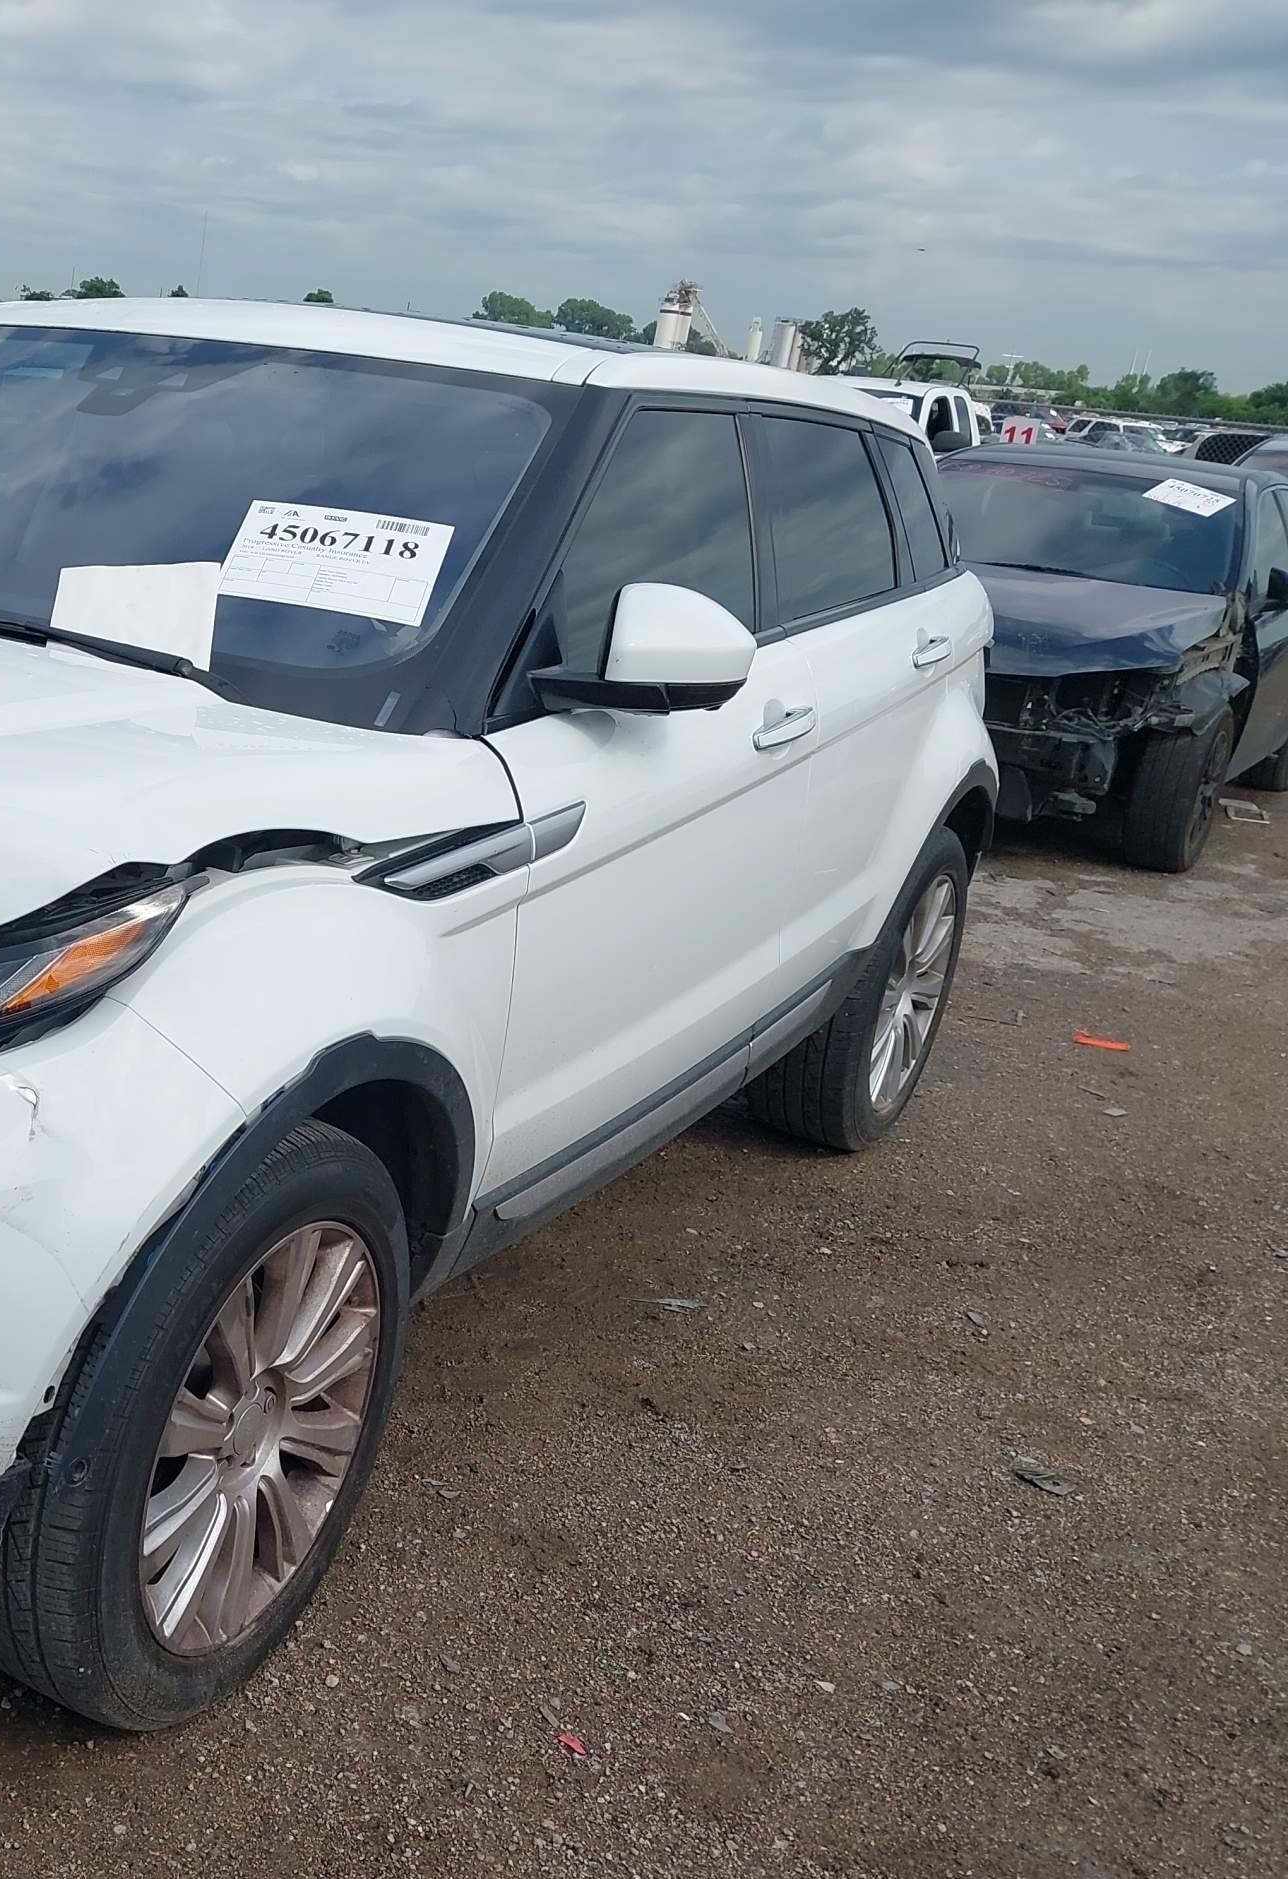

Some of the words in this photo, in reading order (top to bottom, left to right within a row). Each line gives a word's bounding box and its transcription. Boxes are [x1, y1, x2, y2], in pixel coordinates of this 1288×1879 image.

[1004, 424, 1034, 444] 11
[243, 537, 290, 549] Progressive
[291, 543, 326, 554] Casualty
[328, 548, 368, 559] Insurance
[259, 522, 420, 560] 45067118
